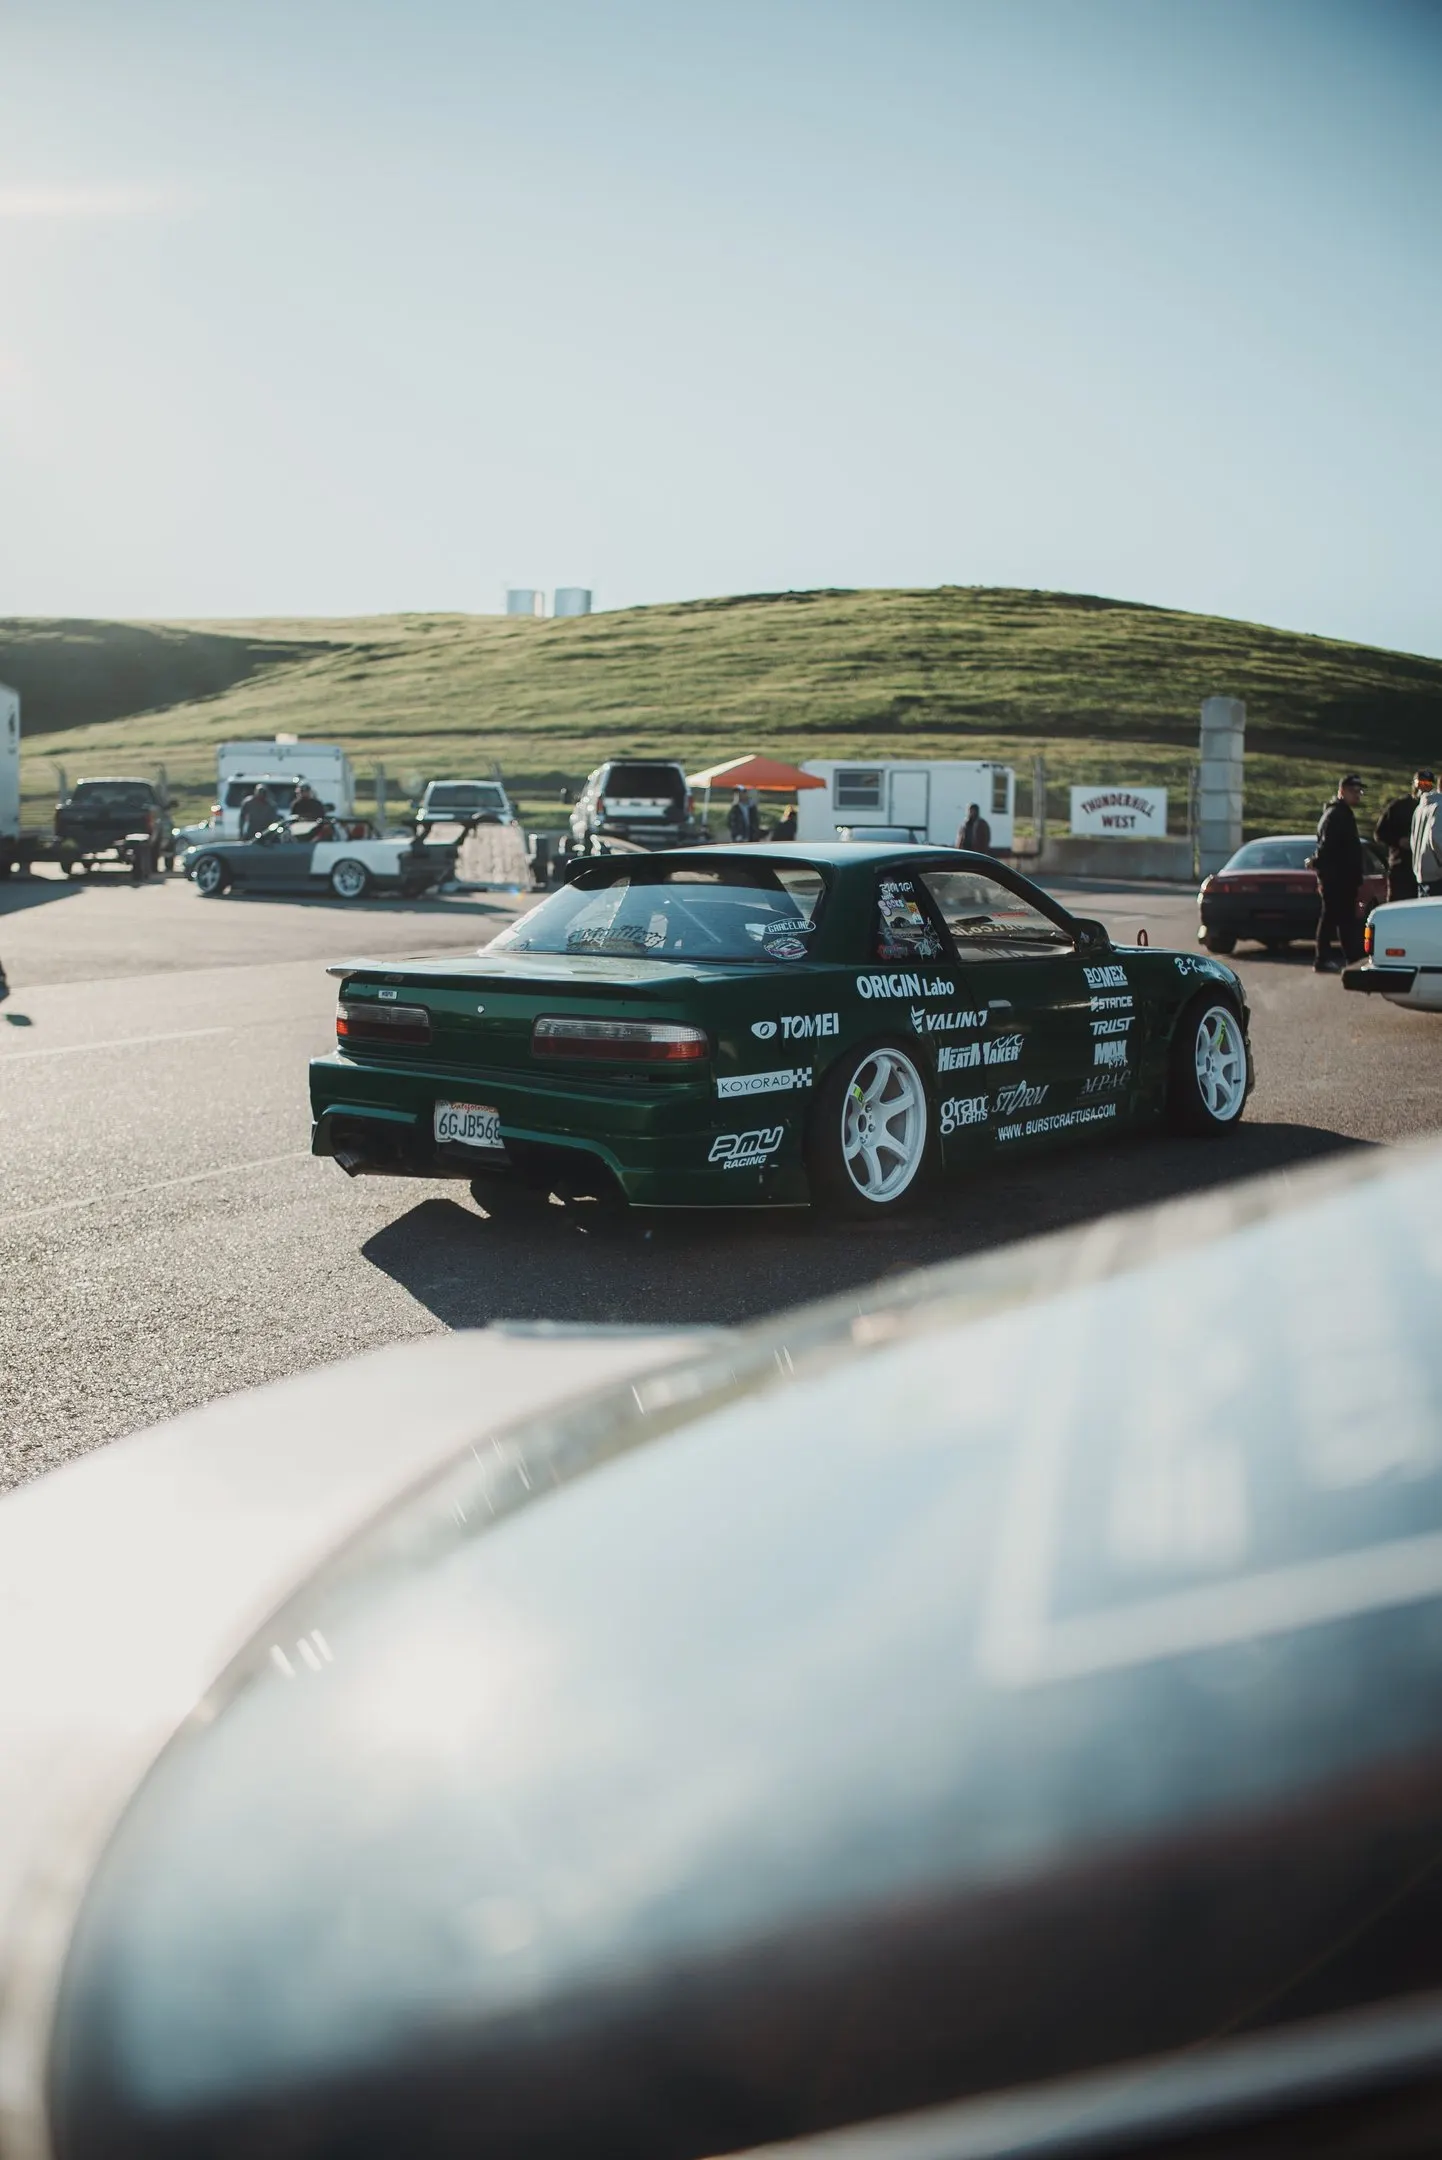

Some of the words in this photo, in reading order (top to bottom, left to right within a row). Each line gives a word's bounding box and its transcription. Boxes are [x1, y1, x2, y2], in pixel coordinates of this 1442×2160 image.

[1101, 814, 1136, 829] WEST
[856, 973, 922, 999] ORIGIN
[922, 976, 955, 996] Labo
[1083, 965, 1128, 988] BOMEX
[780, 1012, 840, 1039] TOMEI
[925, 1009, 989, 1031] VALINO
[1089, 1016, 1136, 1036] TRUST
[721, 1074, 791, 1094] KOYORAD
[723, 1154, 767, 1170] RACING
